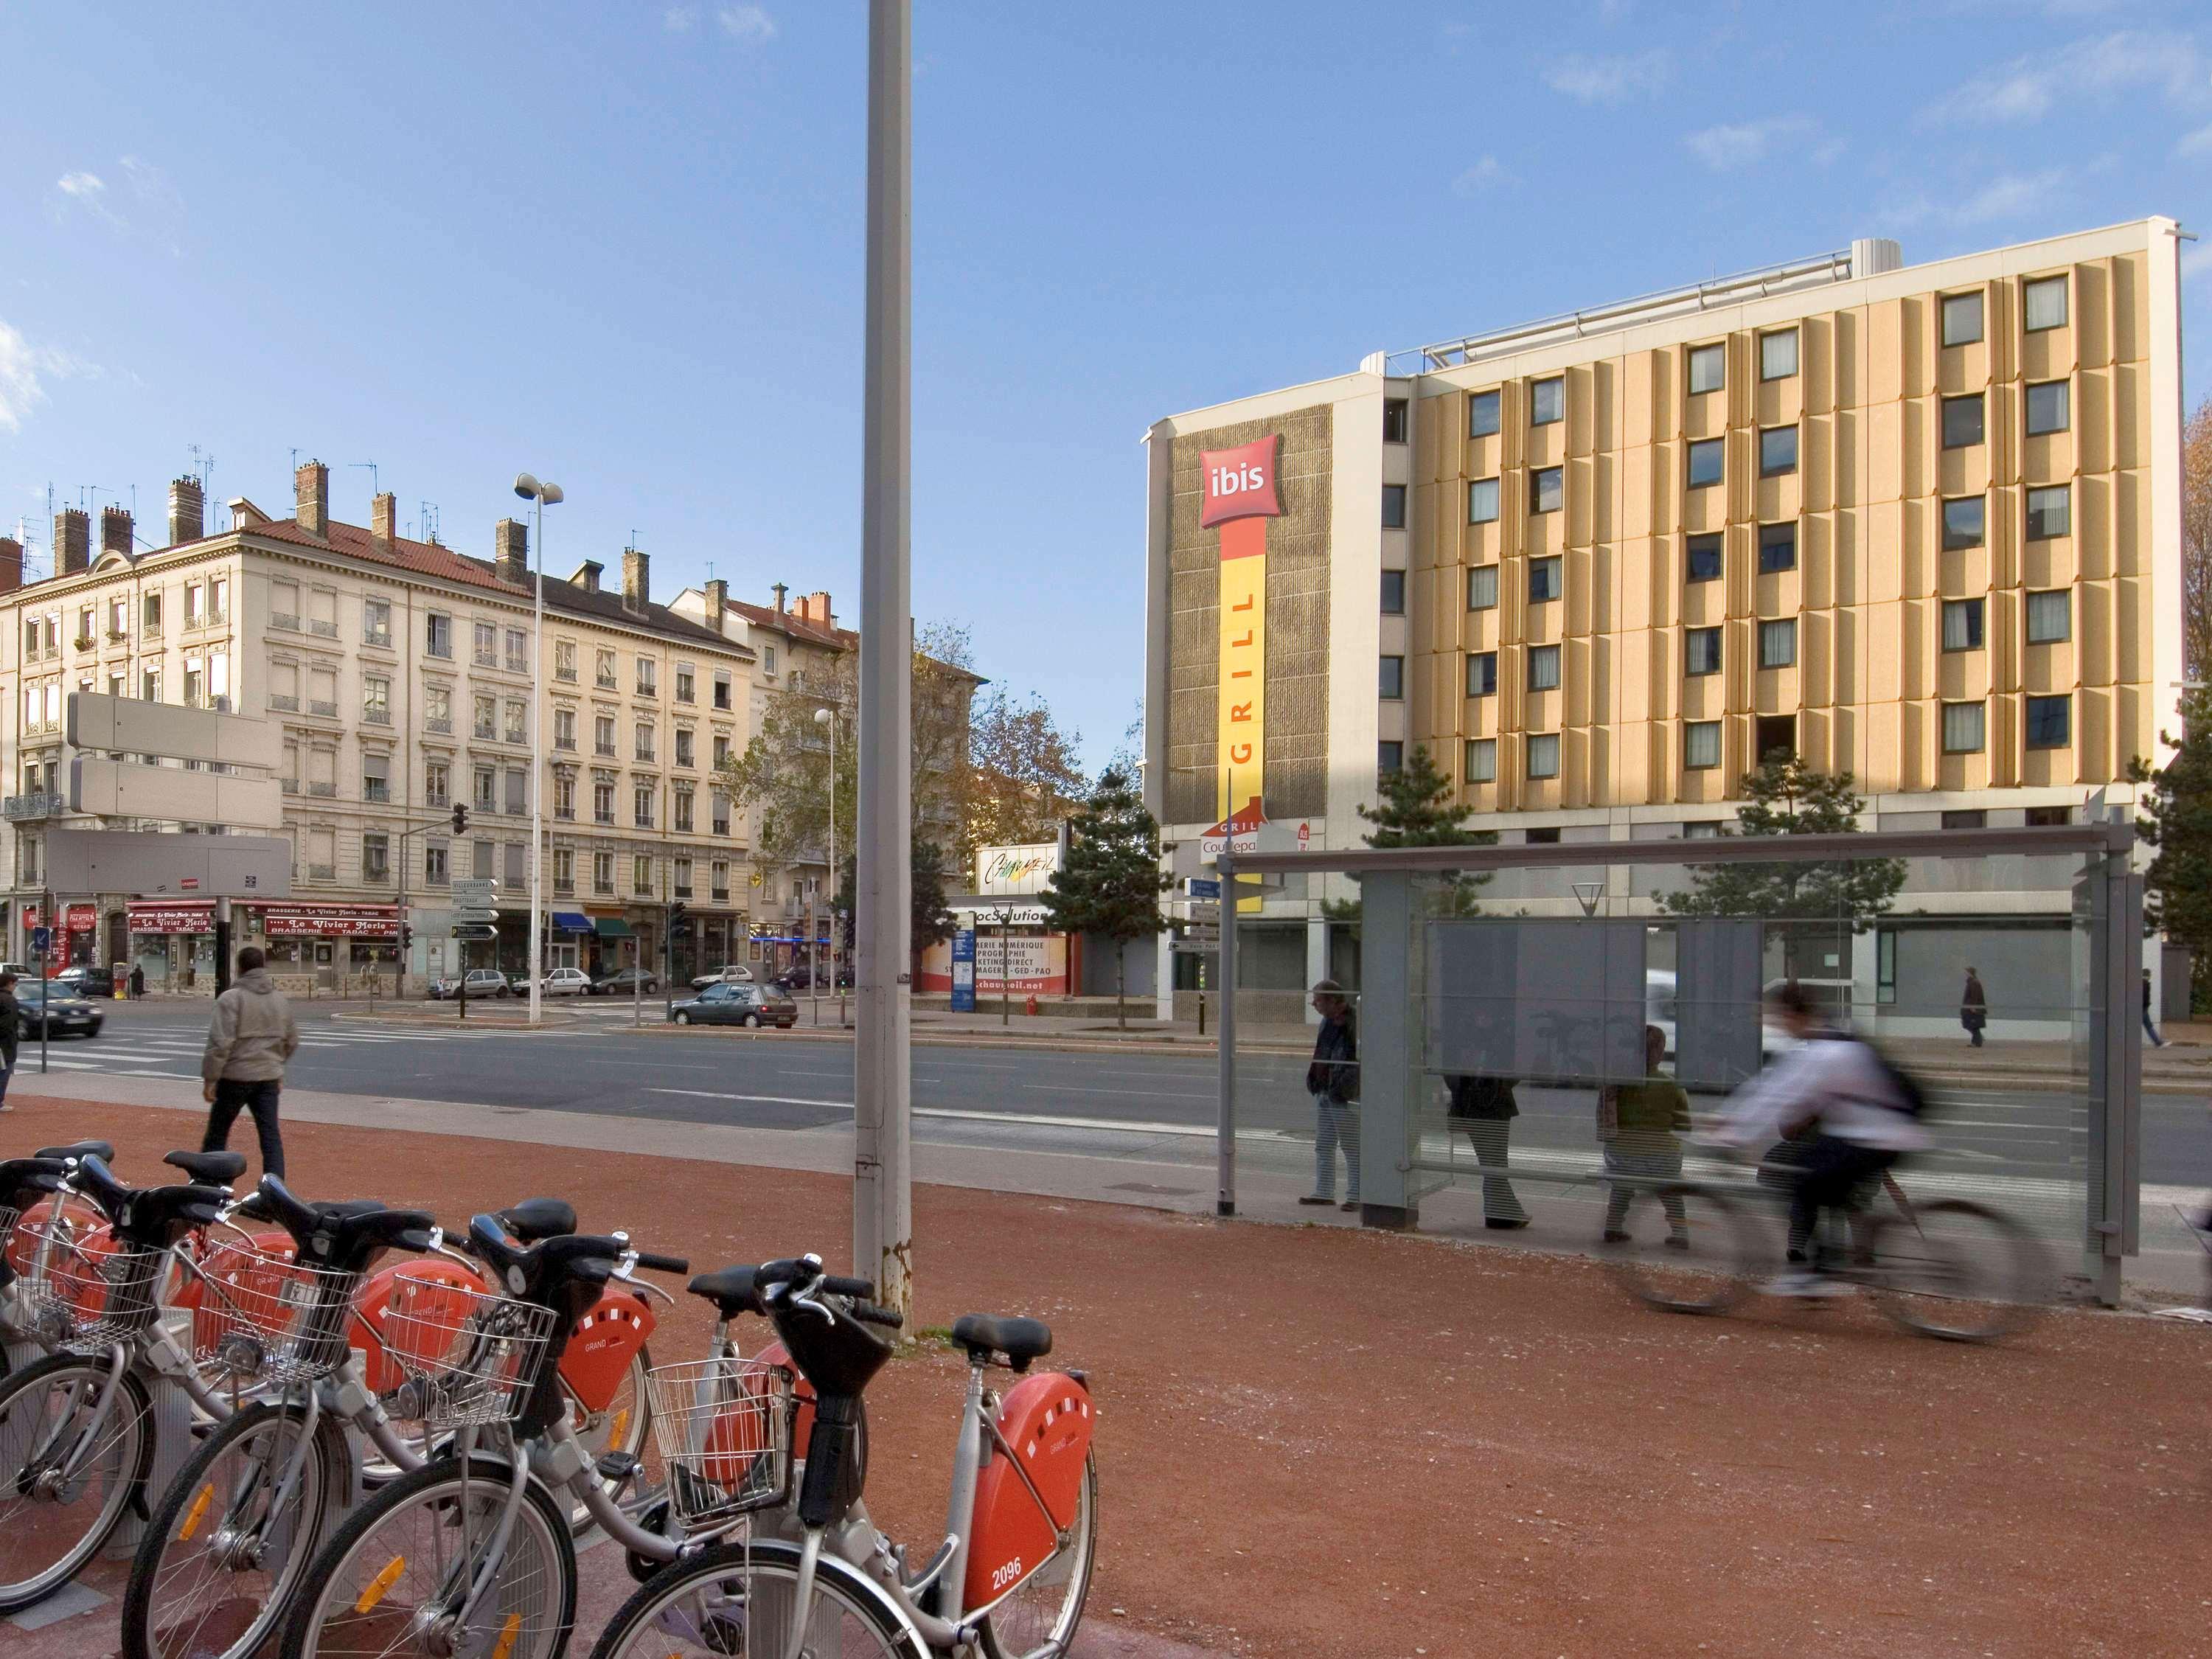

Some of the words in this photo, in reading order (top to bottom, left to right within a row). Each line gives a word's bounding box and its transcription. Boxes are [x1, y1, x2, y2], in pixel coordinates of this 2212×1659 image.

[1211, 462, 1264, 497] ibis
[1231, 594, 1253, 764] GRILL
[1220, 822, 1257, 832] GRIL
[969, 909, 1048, 922] ocSolution
[142, 919, 153, 927] Le
[156, 918, 181, 927] Vivier
[185, 918, 207, 927] Merle
[289, 919, 306, 928] Le
[313, 920, 349, 929] Vivier
[355, 921, 386, 930] Merle
[975, 981, 1043, 989] .chaueil.net
[585, 1339, 607, 1352] GRAND
[992, 1557, 1021, 1590] 2096
